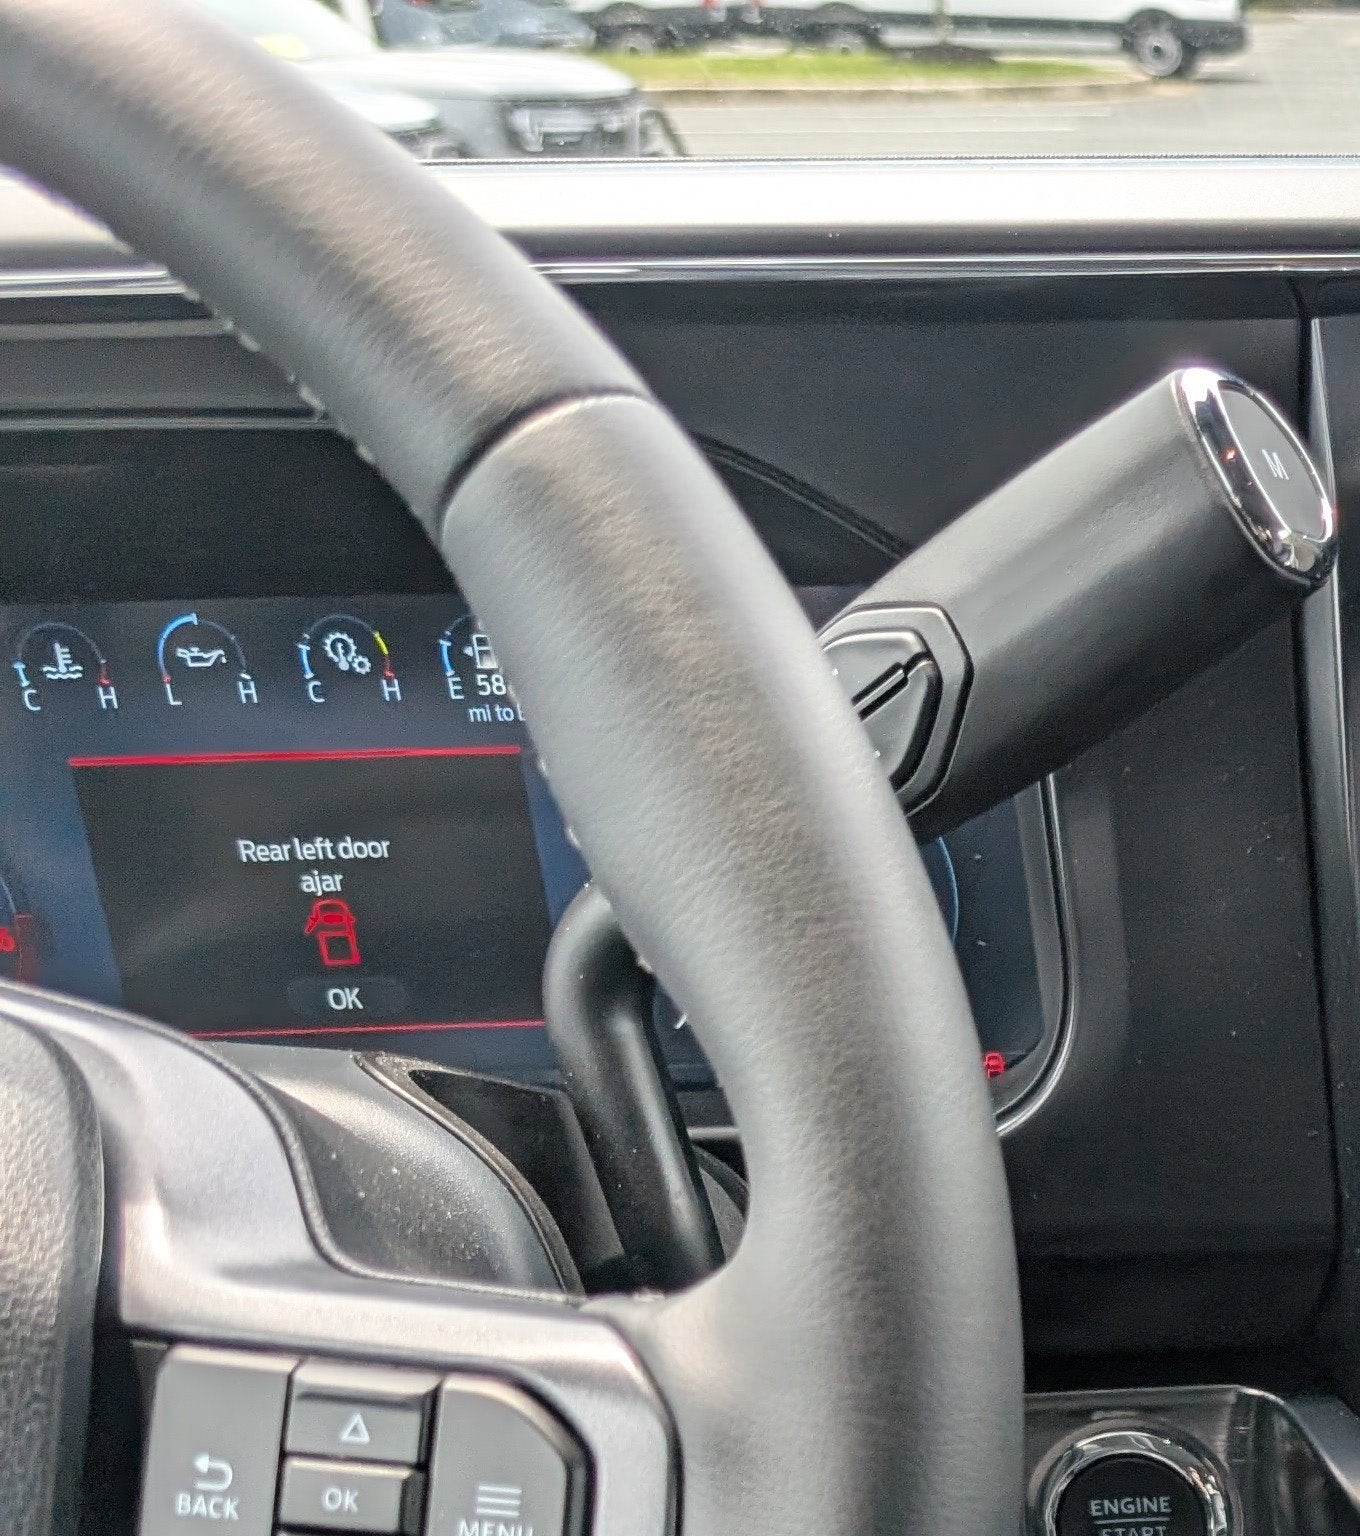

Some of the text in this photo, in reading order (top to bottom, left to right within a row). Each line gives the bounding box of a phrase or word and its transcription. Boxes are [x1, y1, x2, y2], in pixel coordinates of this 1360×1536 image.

[24, 689, 40, 711] C
[98, 687, 118, 708] H
[166, 684, 182, 705] L
[238, 682, 257, 703] H
[308, 681, 324, 702] C
[382, 680, 401, 700] H
[469, 705, 491, 722] mi
[495, 705, 514, 721] to
[238, 836, 389, 862] Rear left door
[301, 870, 342, 896] ajar
[328, 988, 363, 1010] OK
[176, 1493, 238, 1519] BACK
[323, 1487, 357, 1511] OK
[1091, 1497, 1171, 1516] ENGINE
